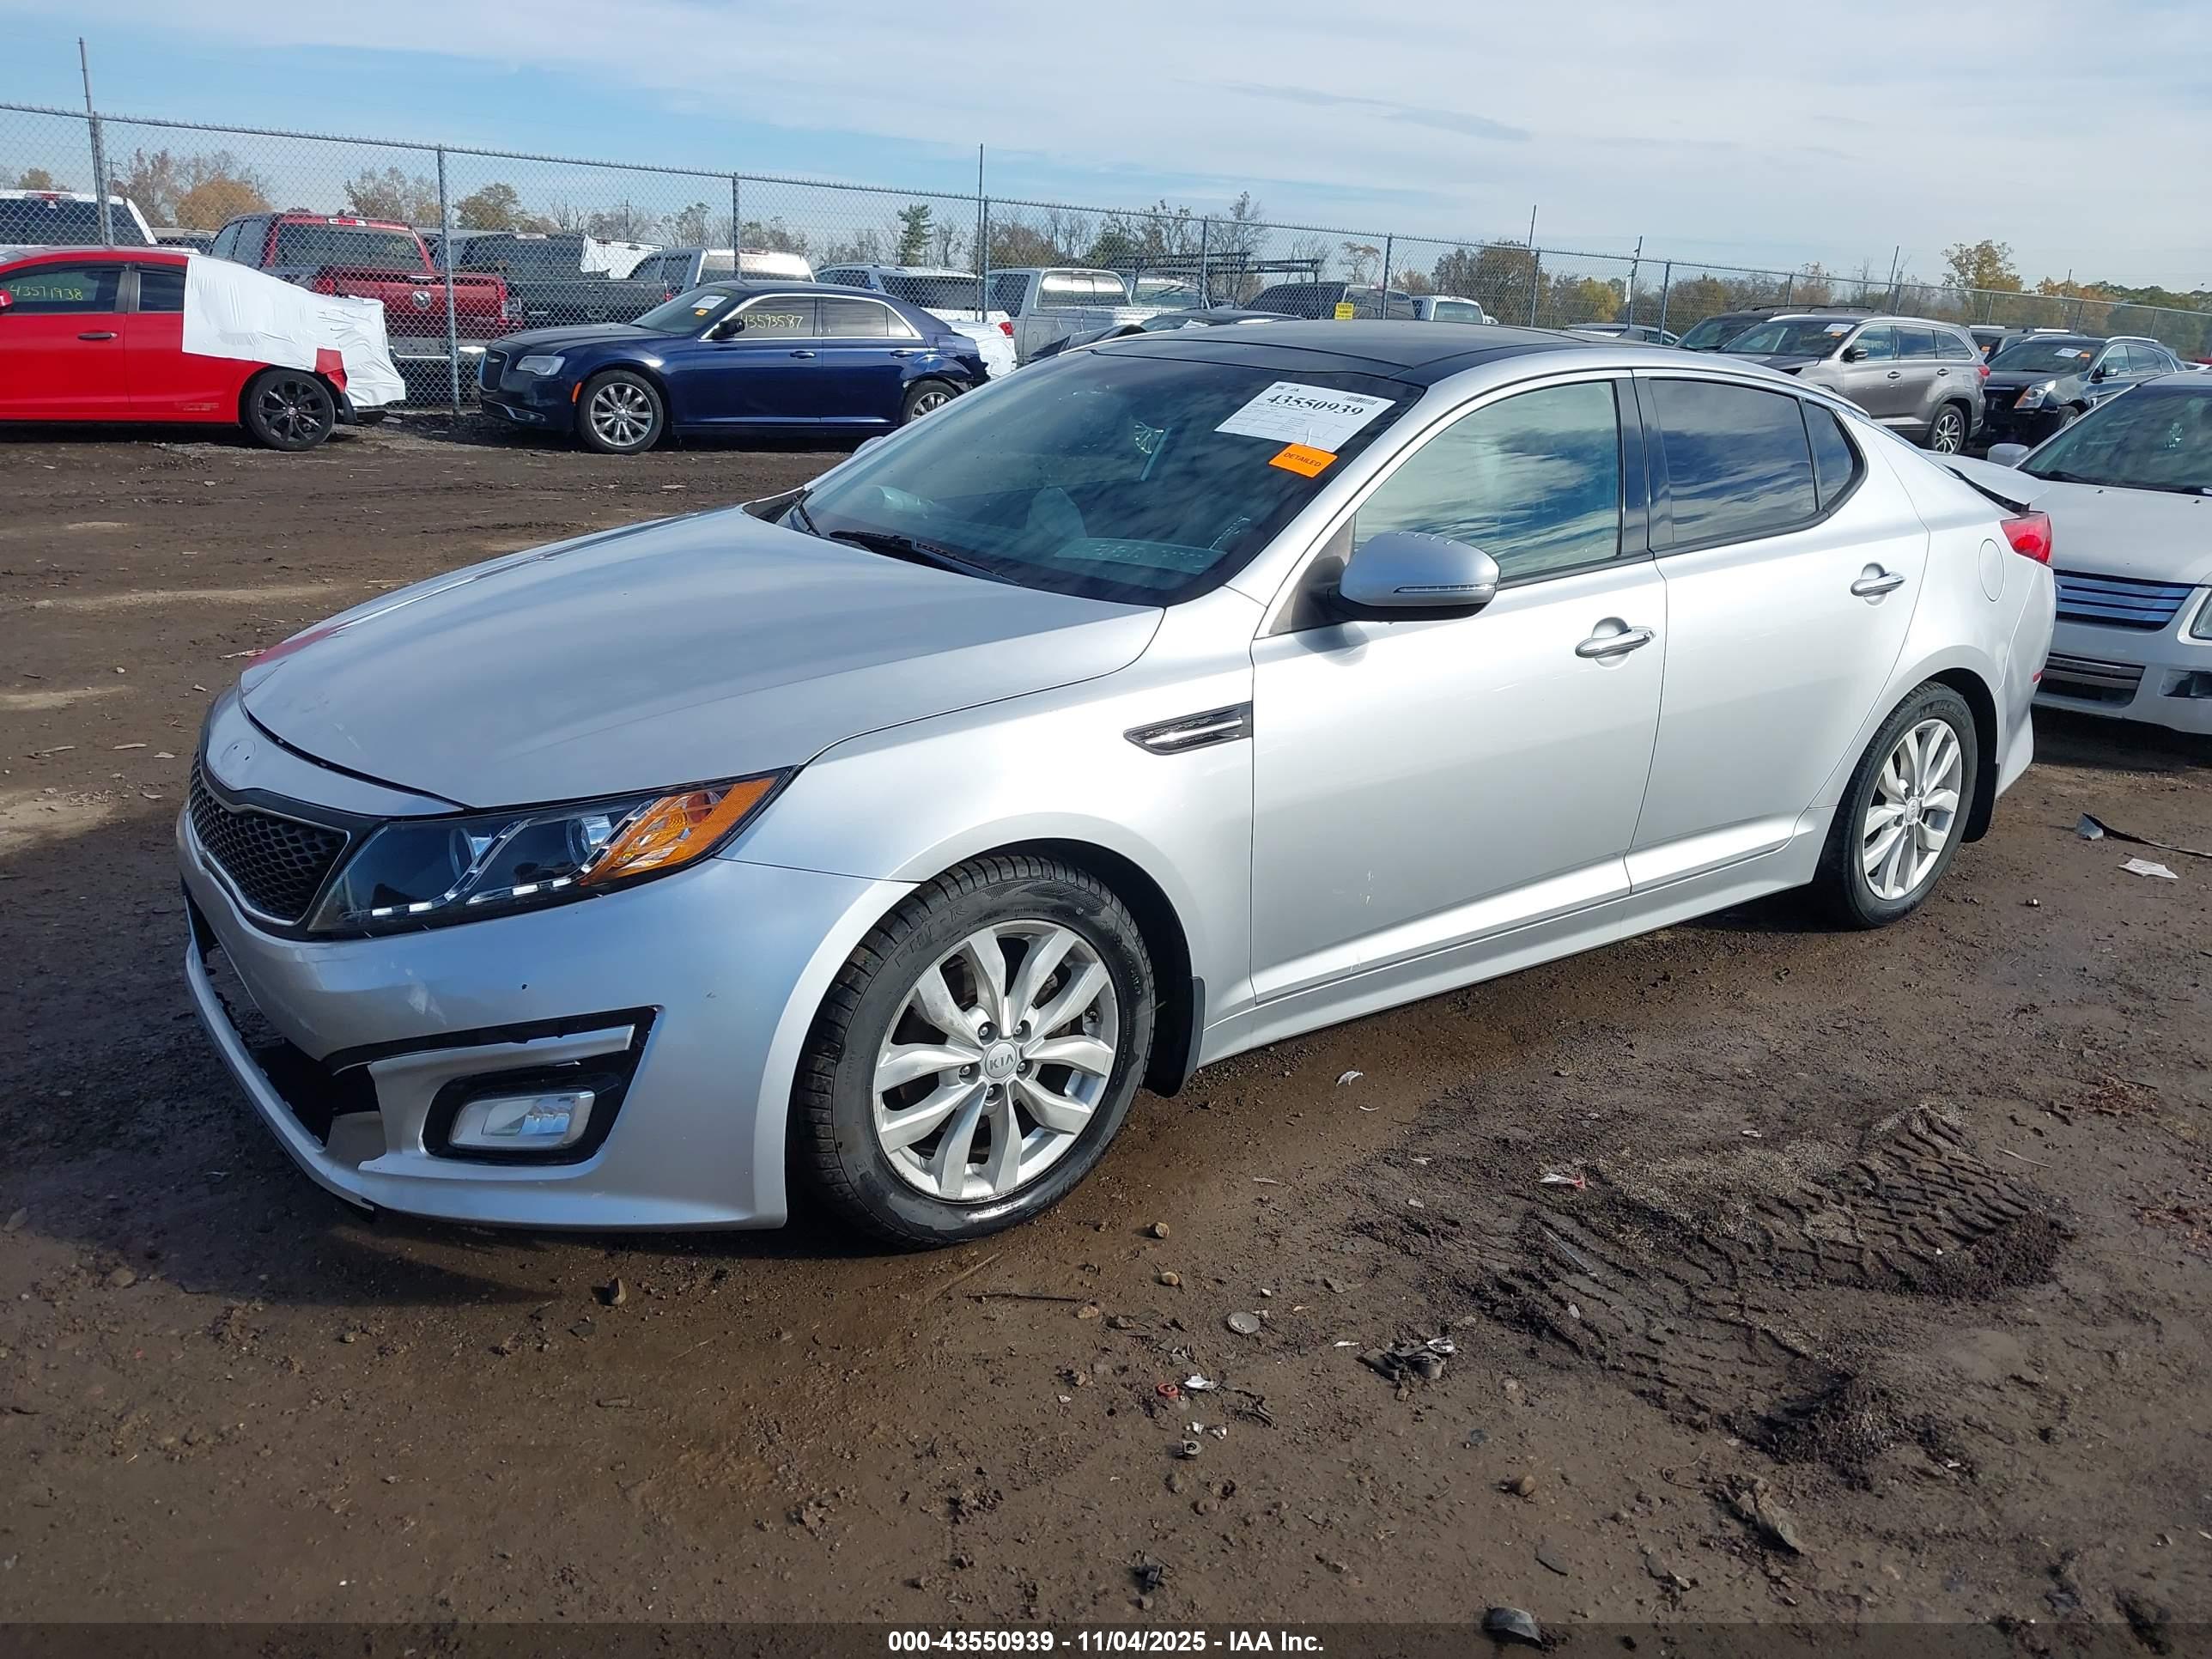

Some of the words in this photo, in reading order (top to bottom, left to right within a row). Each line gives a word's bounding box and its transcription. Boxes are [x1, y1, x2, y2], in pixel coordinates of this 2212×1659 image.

[1266, 393, 1364, 416] 43550939
[1283, 451, 1322, 468] DETAILED
[989, 1054, 1013, 1071] KIA
